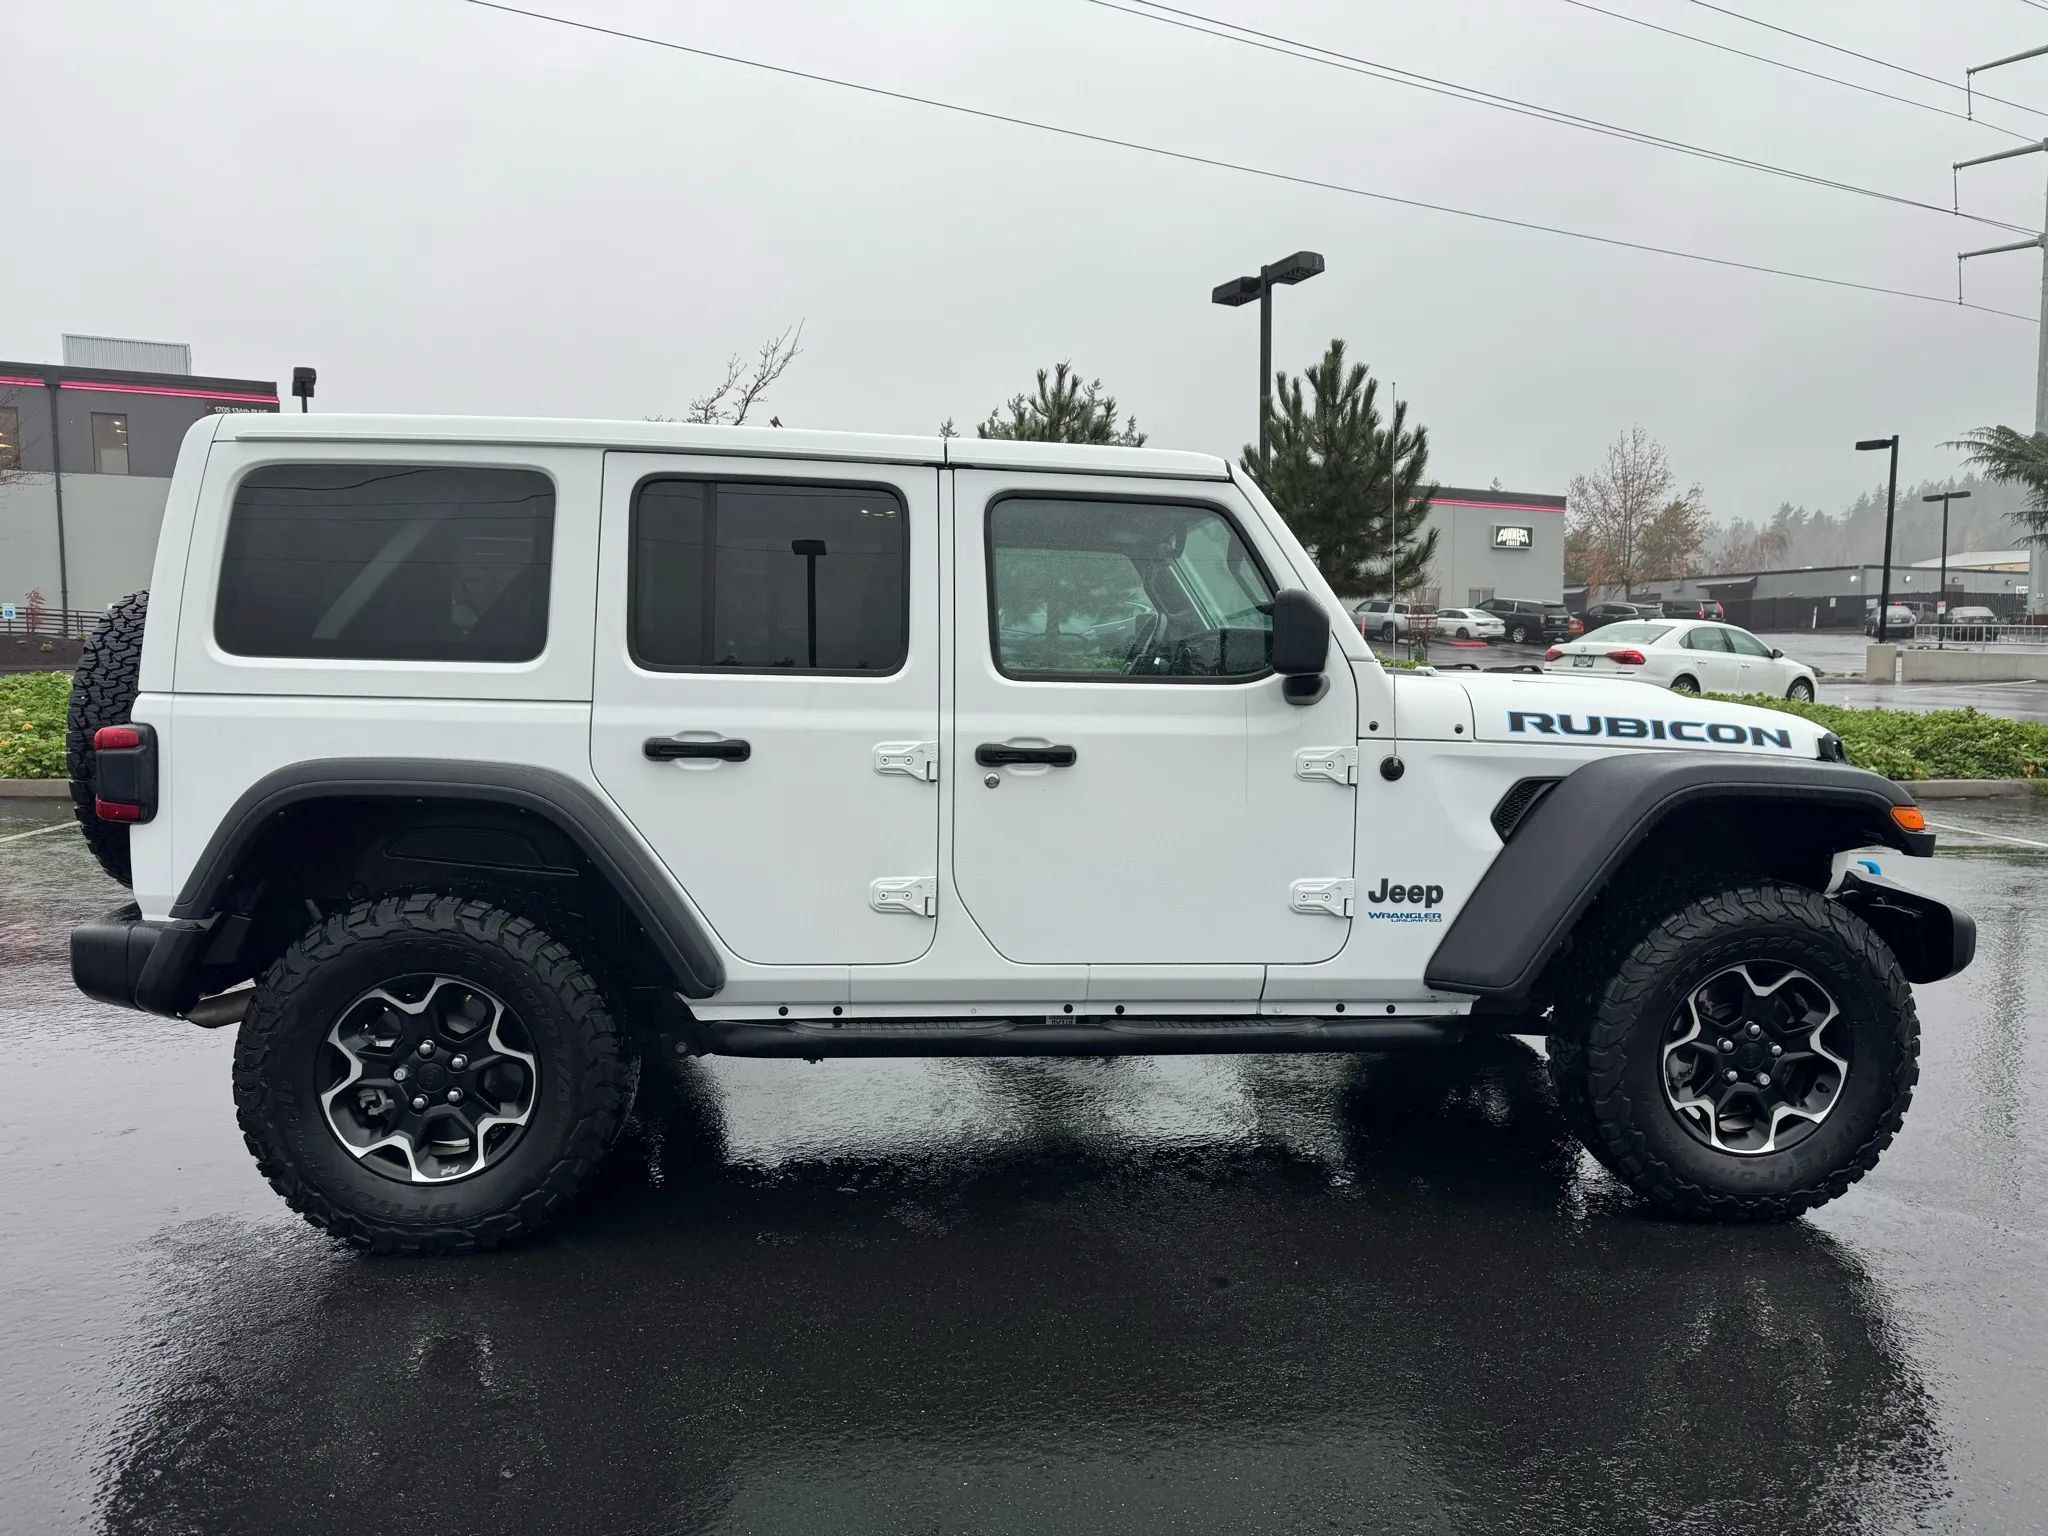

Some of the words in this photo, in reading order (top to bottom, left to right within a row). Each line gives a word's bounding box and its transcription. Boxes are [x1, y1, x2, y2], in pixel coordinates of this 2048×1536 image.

[1507, 710, 1792, 749] RUBICON
[1368, 878, 1444, 908] Jeep
[1368, 911, 1442, 919] WRANGLER
